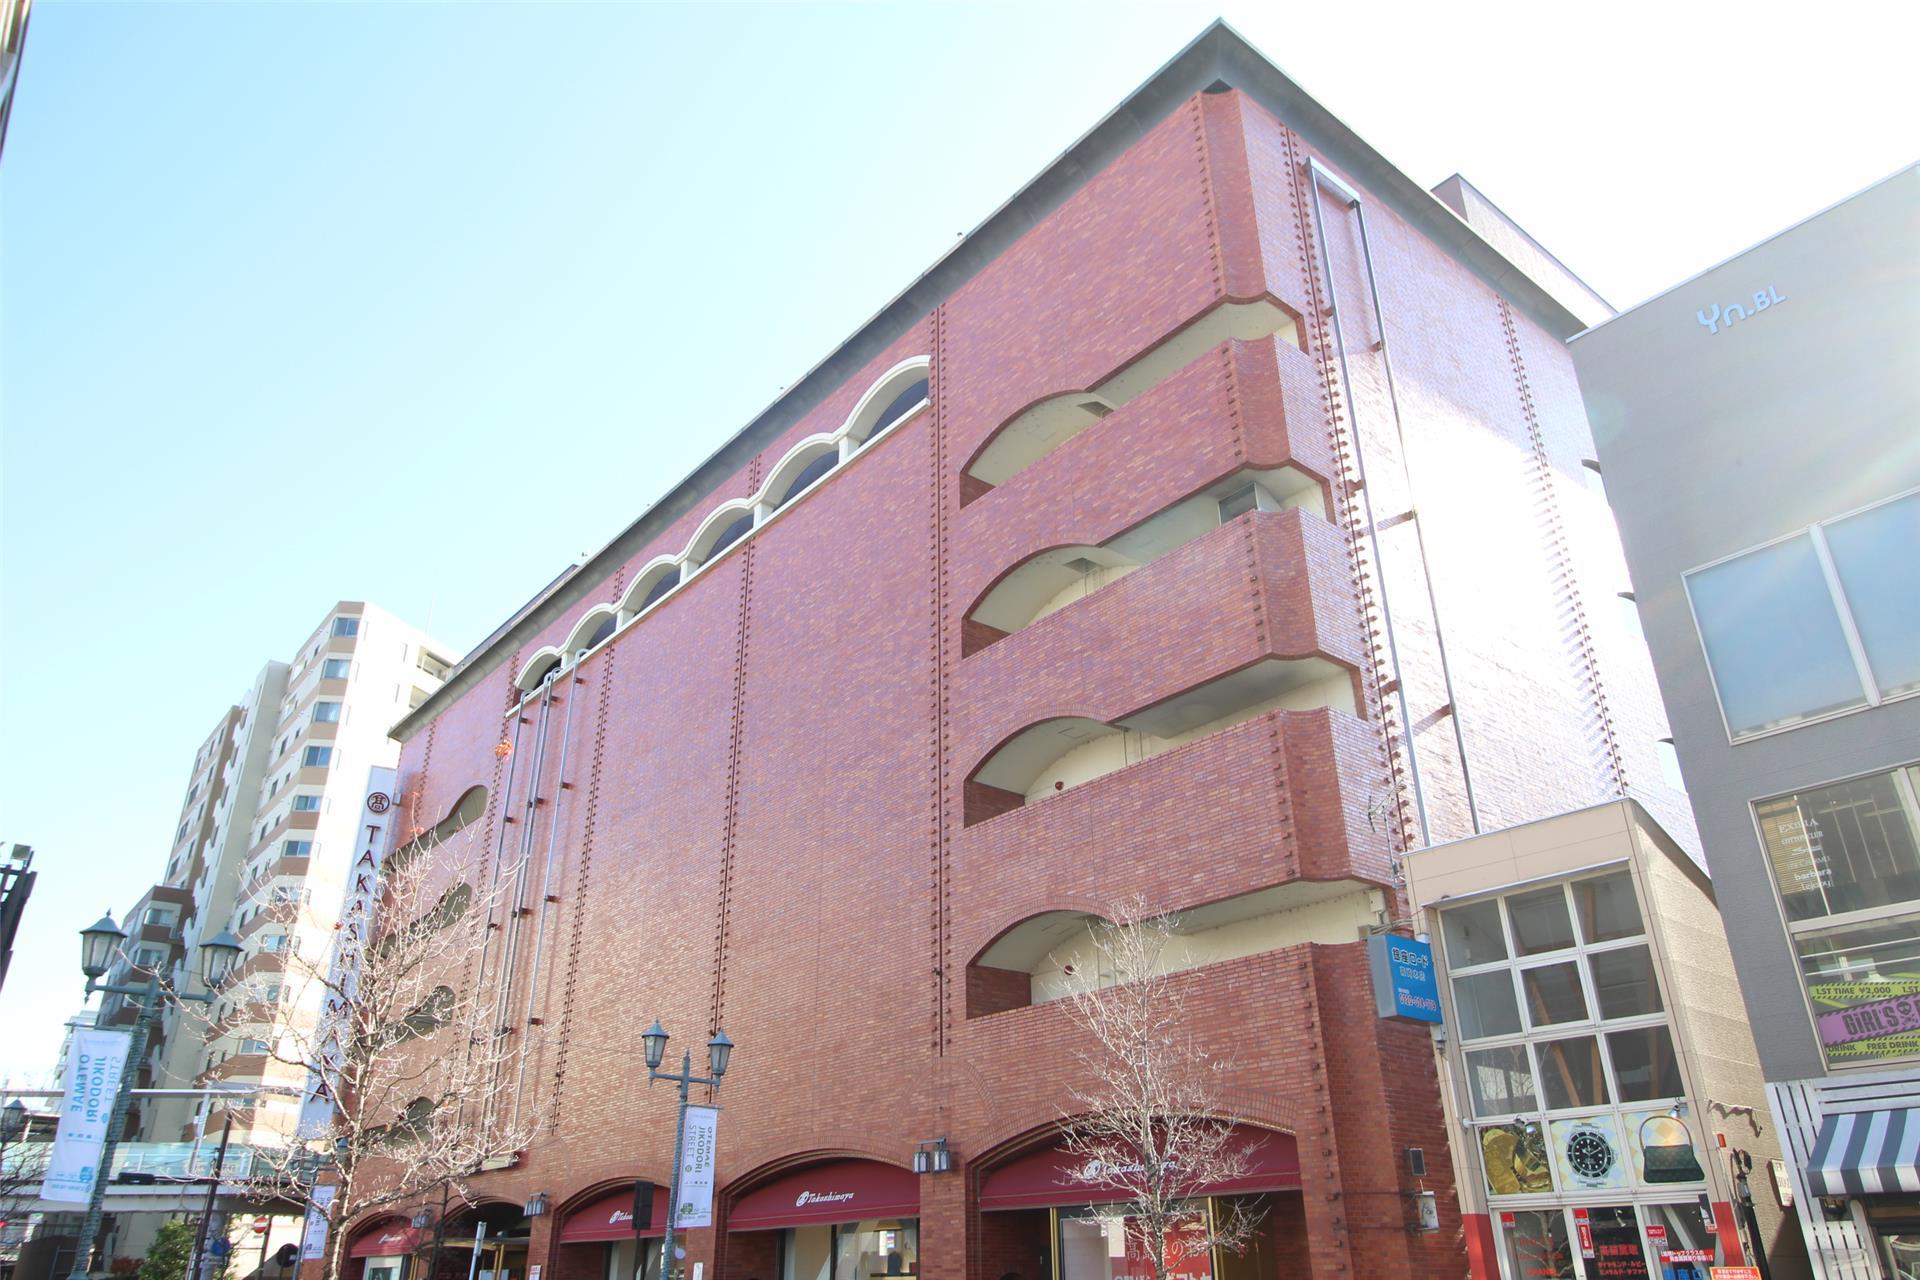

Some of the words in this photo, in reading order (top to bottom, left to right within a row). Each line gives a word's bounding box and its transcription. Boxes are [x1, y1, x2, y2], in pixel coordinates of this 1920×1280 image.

[1867, 1042, 1888, 1050] FREE
[1889, 1040, 1920, 1049] DRINK
[687, 1124, 697, 1158] STREET
[808, 1191, 854, 1203] Takashimaya
